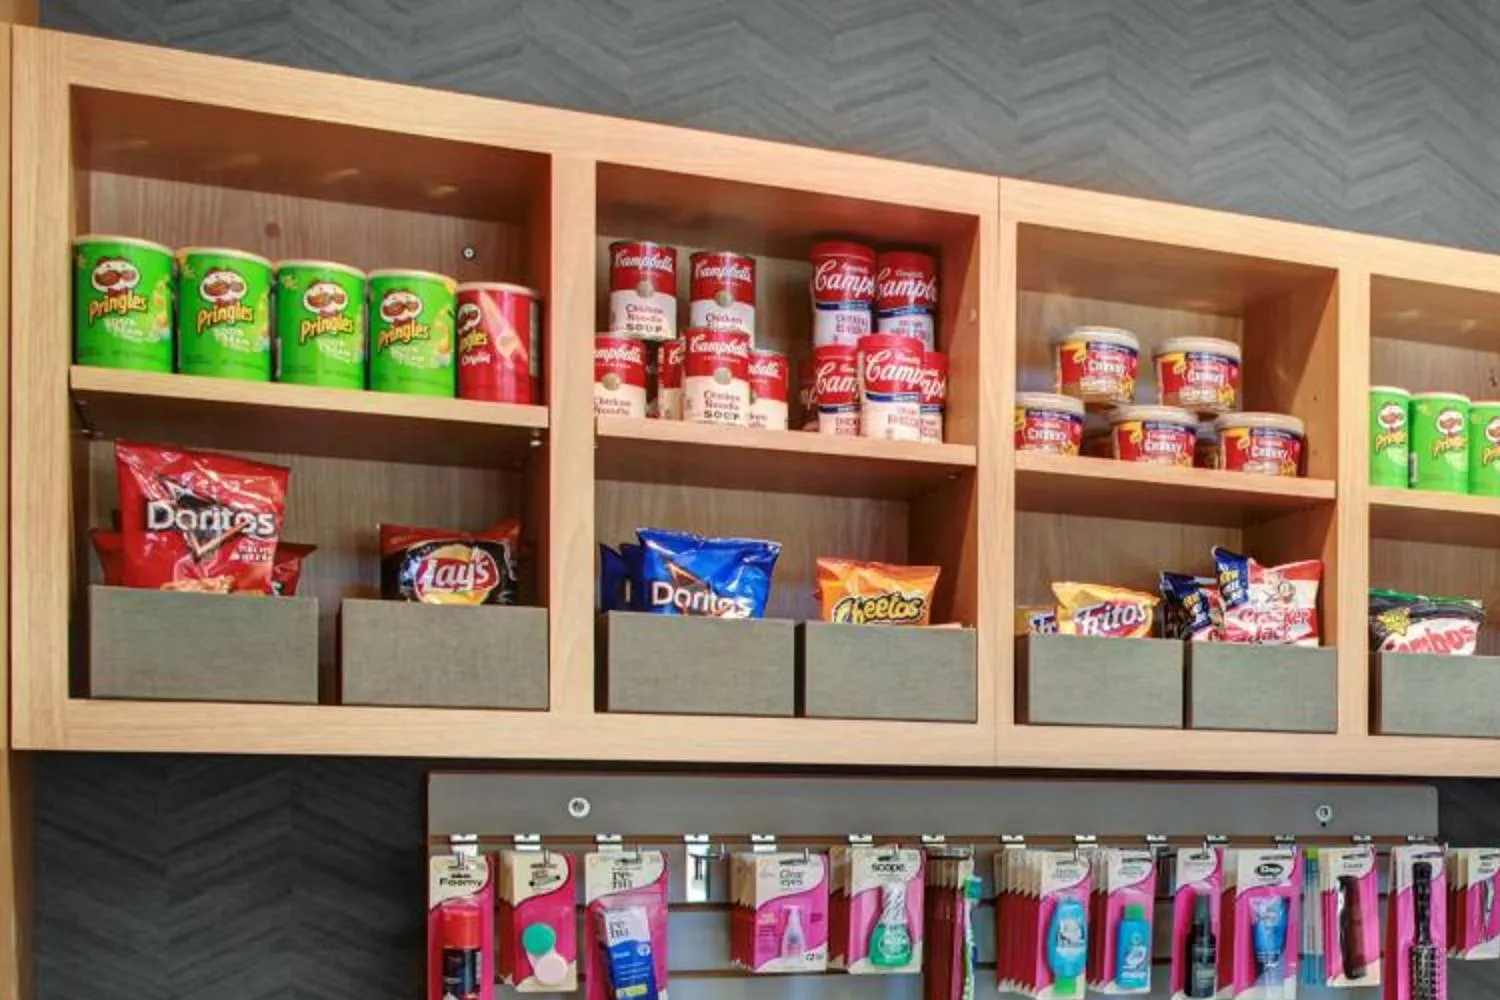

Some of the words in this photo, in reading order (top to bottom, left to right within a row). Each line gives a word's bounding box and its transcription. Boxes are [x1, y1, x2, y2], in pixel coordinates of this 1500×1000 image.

[87, 293, 148, 327] Pringles
[195, 302, 254, 333] Pringles
[299, 315, 355, 346] Pringles
[378, 319, 431, 352] Pringles
[147, 500, 276, 538] Doritos
[421, 556, 491, 593] Lay's
[651, 580, 753, 619] Doritos
[835, 592, 926, 625] Cheetos
[1076, 600, 1148, 633] Fritos
[1384, 625, 1475, 655] Combos
